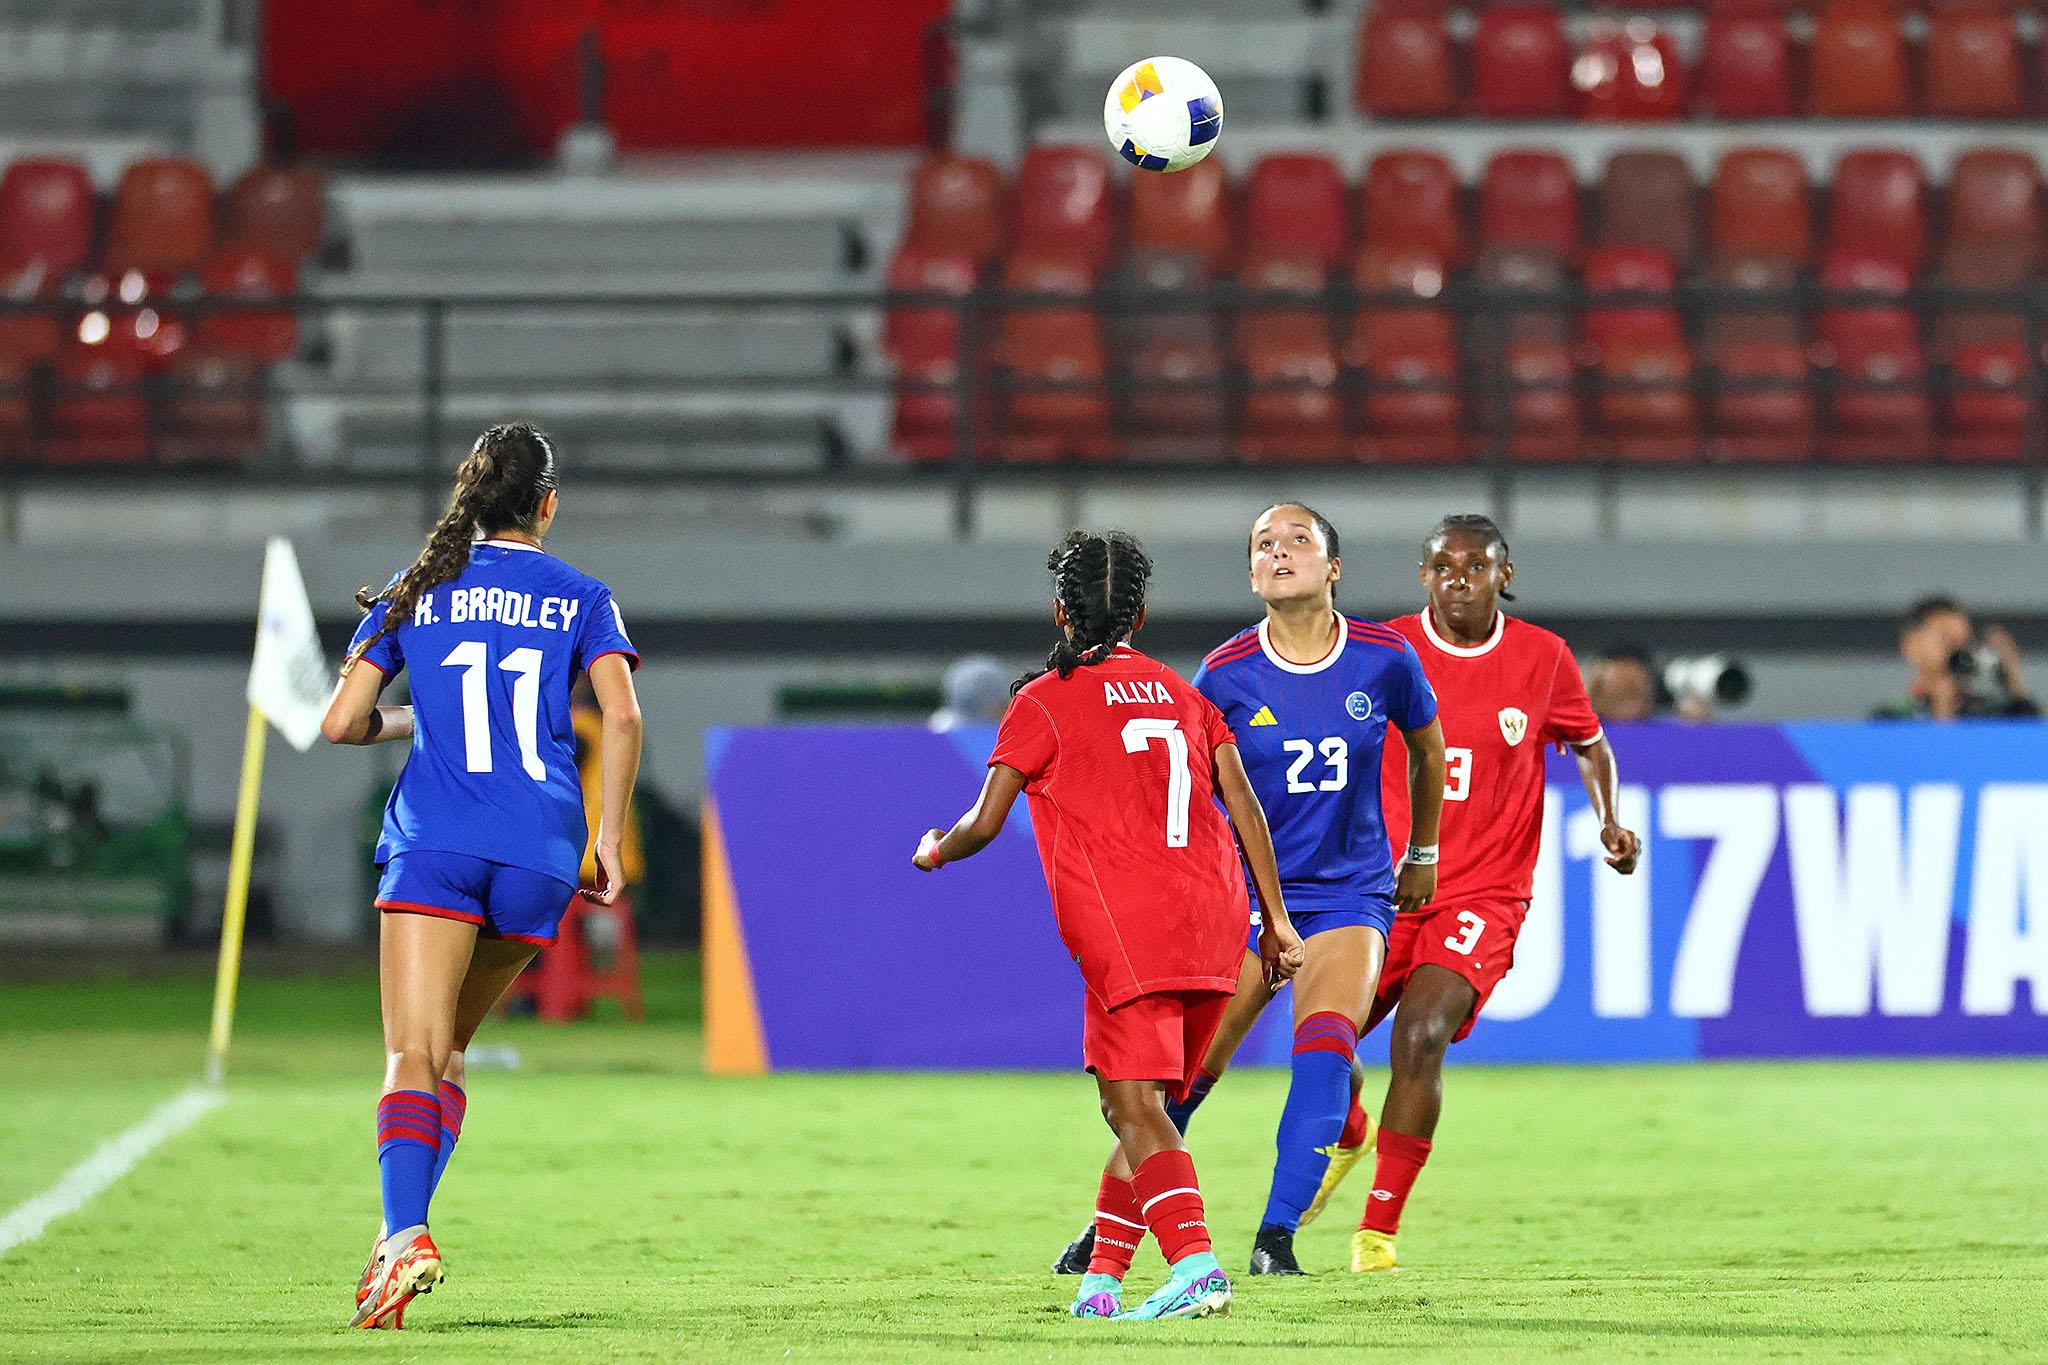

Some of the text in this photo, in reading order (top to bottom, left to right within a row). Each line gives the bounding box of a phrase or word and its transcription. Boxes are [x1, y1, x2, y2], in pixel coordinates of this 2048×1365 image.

[450, 586, 579, 632] BRADLEY
[440, 640, 547, 782] 11
[1103, 681, 1175, 707] ALLYA
[1120, 717, 1193, 849] 7
[1283, 736, 1349, 794] 23
[1442, 746, 1474, 802] 3
[1443, 909, 1488, 956] 3
